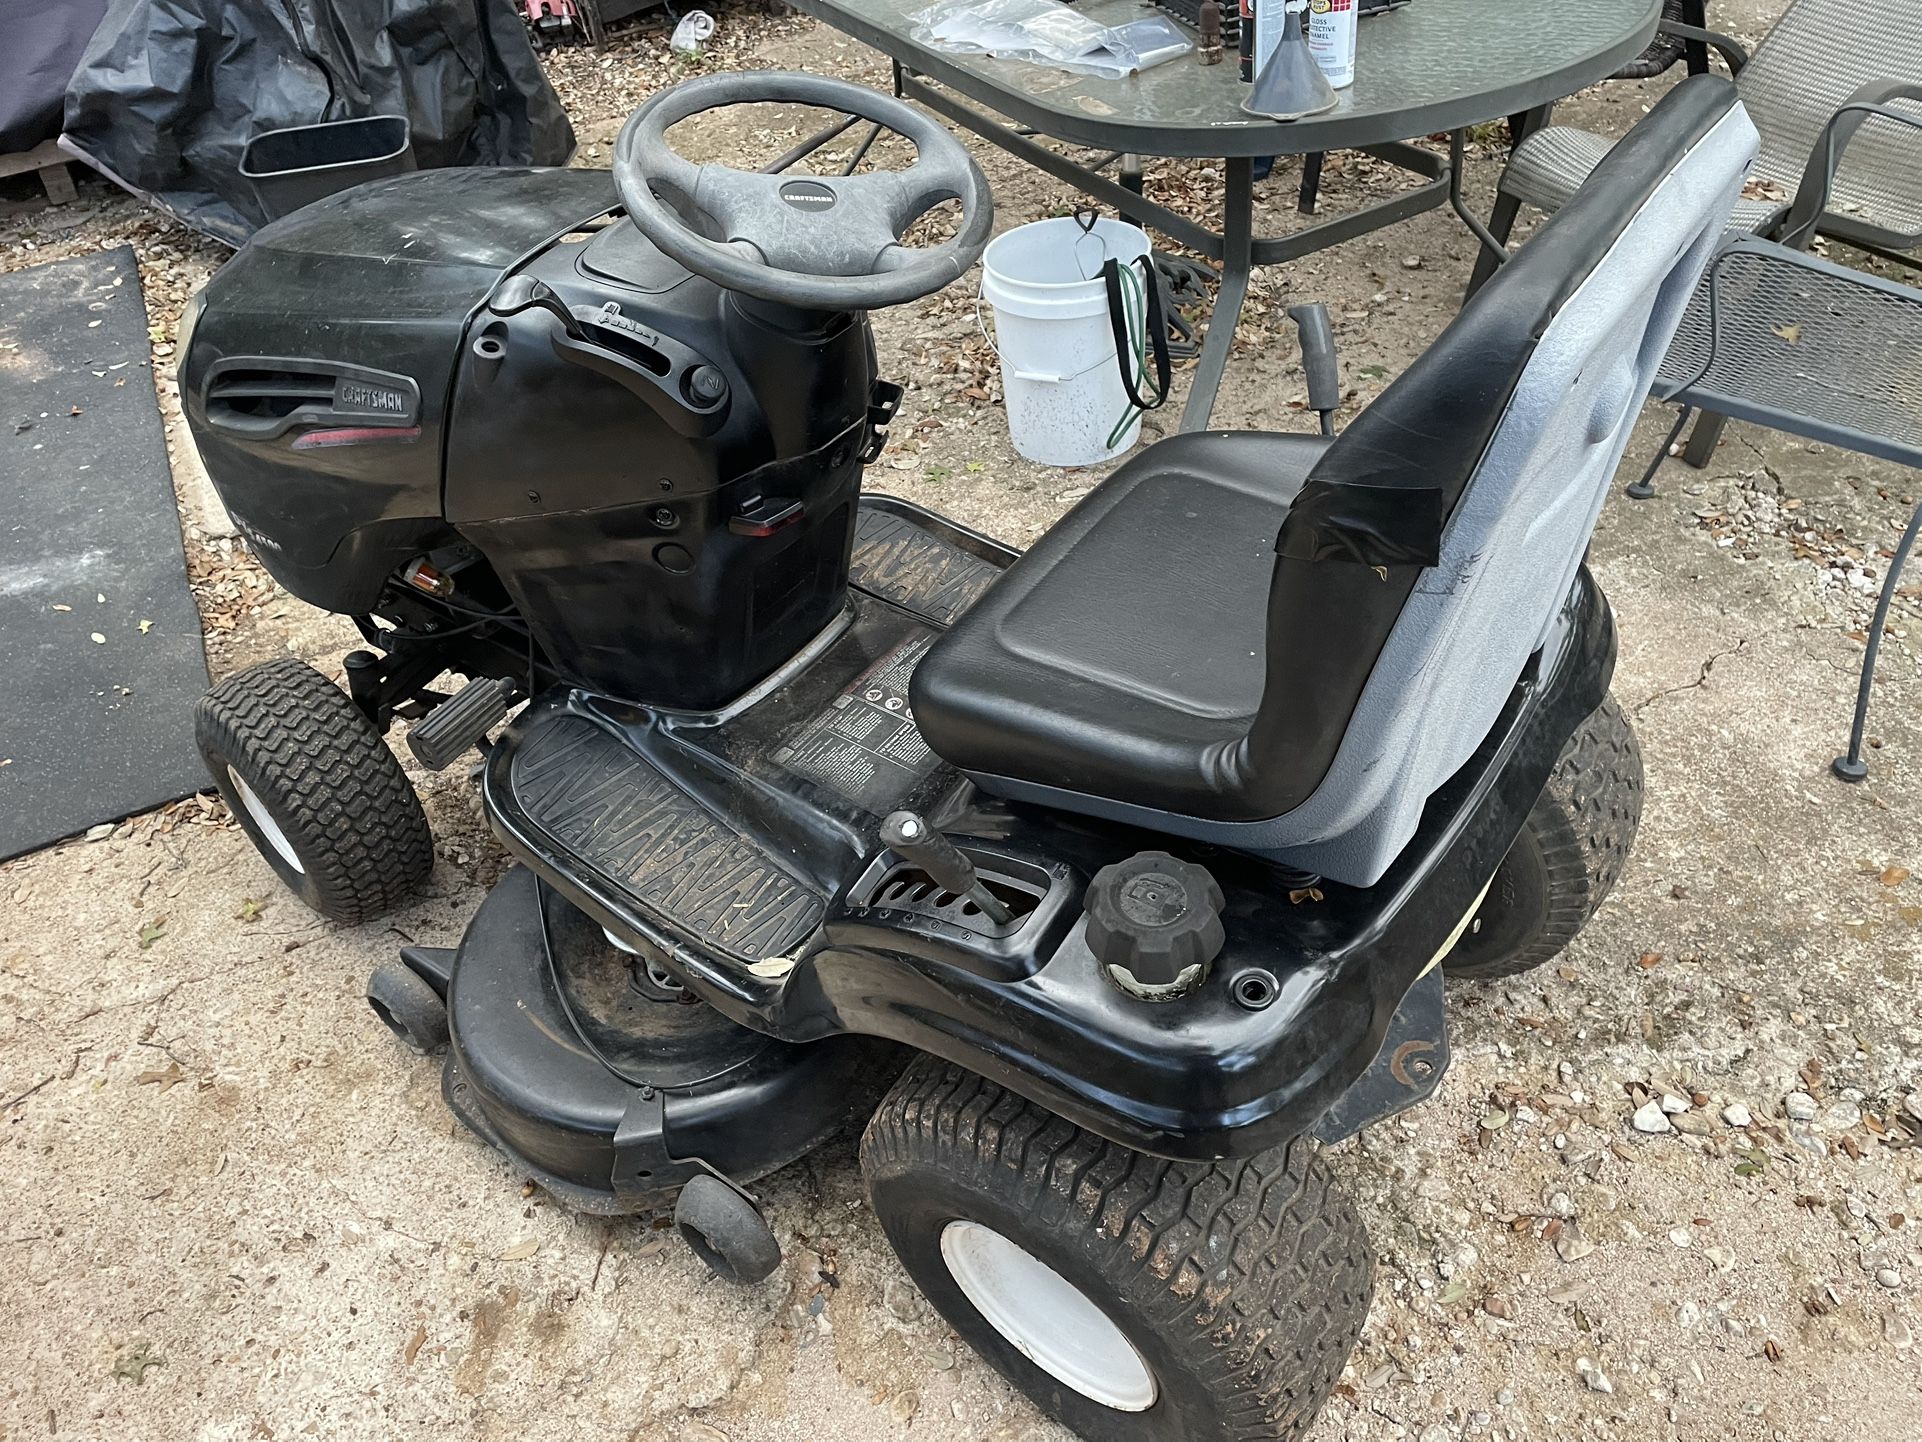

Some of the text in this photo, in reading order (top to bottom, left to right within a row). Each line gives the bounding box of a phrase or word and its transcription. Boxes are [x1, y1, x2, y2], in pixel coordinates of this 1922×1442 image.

[1311, 17, 1328, 25] GLOSS
[784, 194, 833, 202] CRAFTSMAN
[342, 386, 403, 411] CRAFTSMAN
